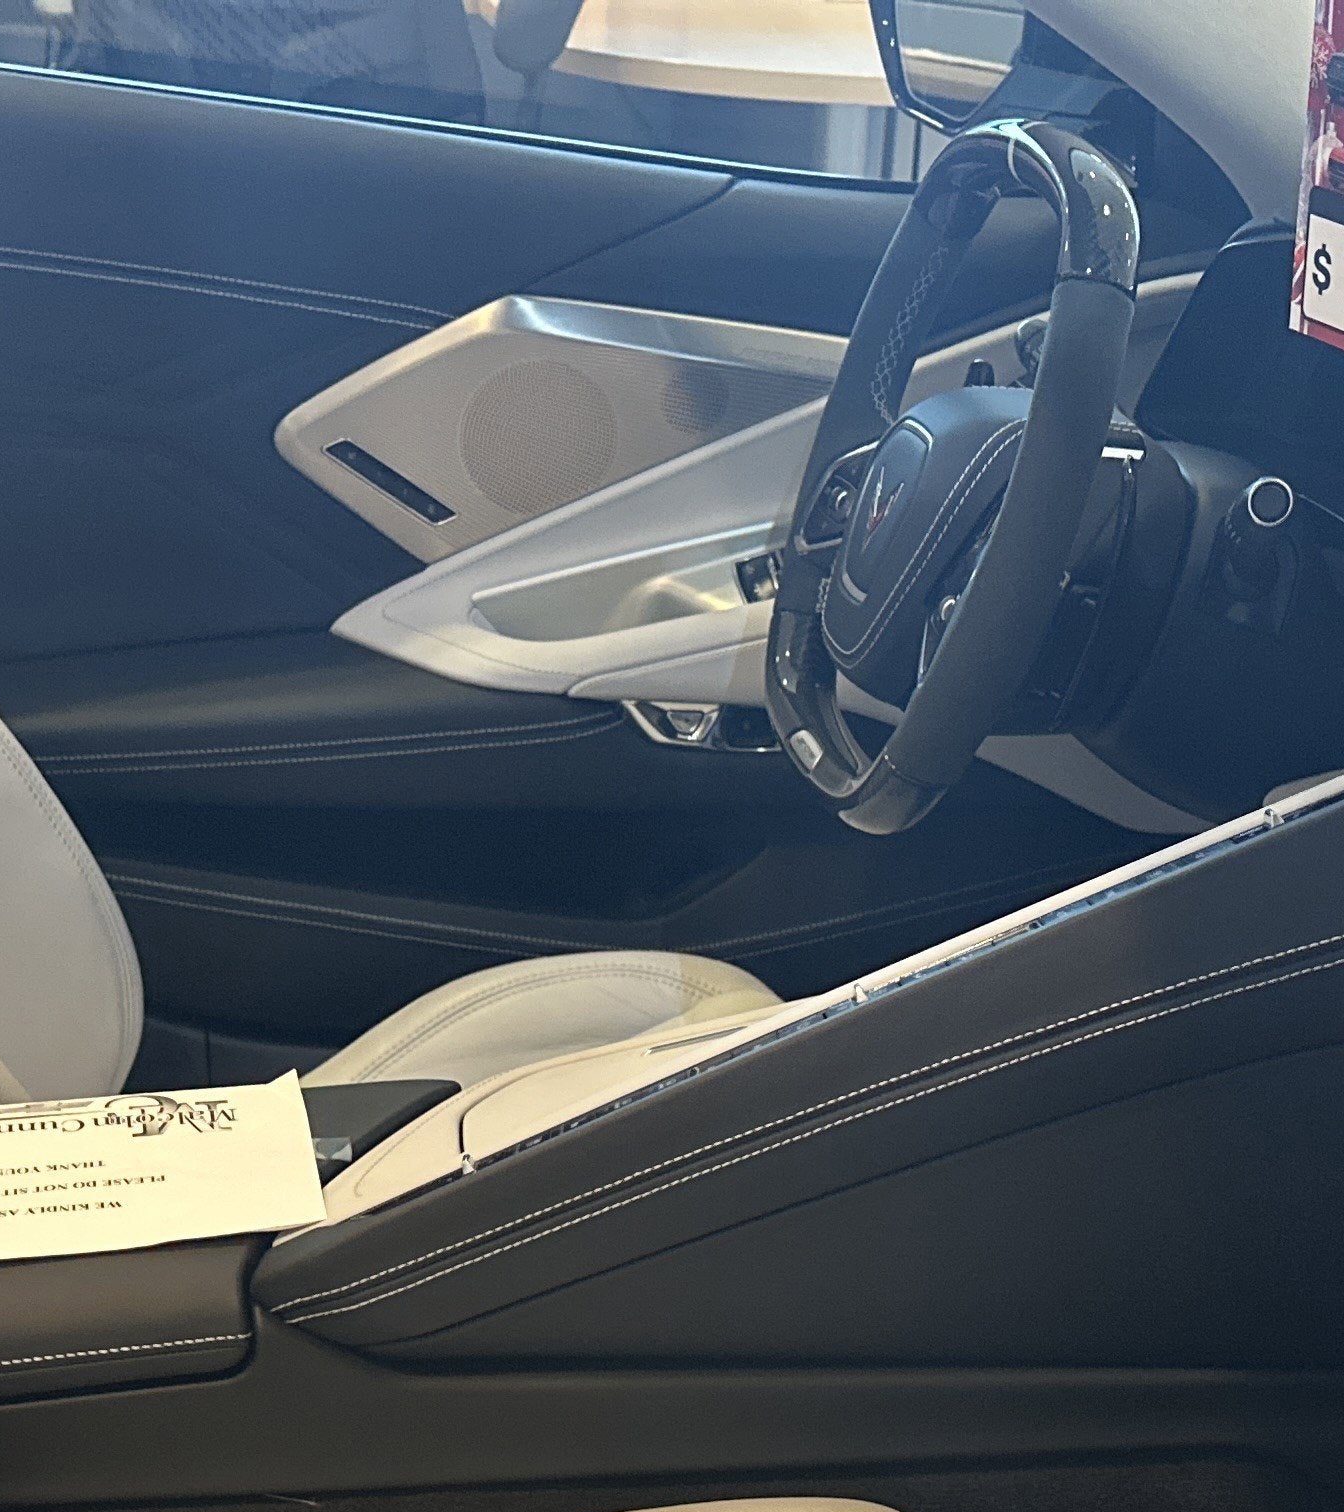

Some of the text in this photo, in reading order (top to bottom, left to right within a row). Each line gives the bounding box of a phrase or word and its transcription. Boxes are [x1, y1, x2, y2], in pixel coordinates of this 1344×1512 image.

[1311, 242, 1333, 296] $
[93, 1108, 238, 1129] Malcolm
[46, 1160, 106, 1172] THANK
[72, 1180, 97, 1190] DO
[102, 1175, 166, 1188] PLEASE
[1, 1187, 28, 1198] SIT
[33, 1182, 68, 1194] NOT
[24, 1202, 90, 1215] KINDLY
[95, 1201, 123, 1211] WE
